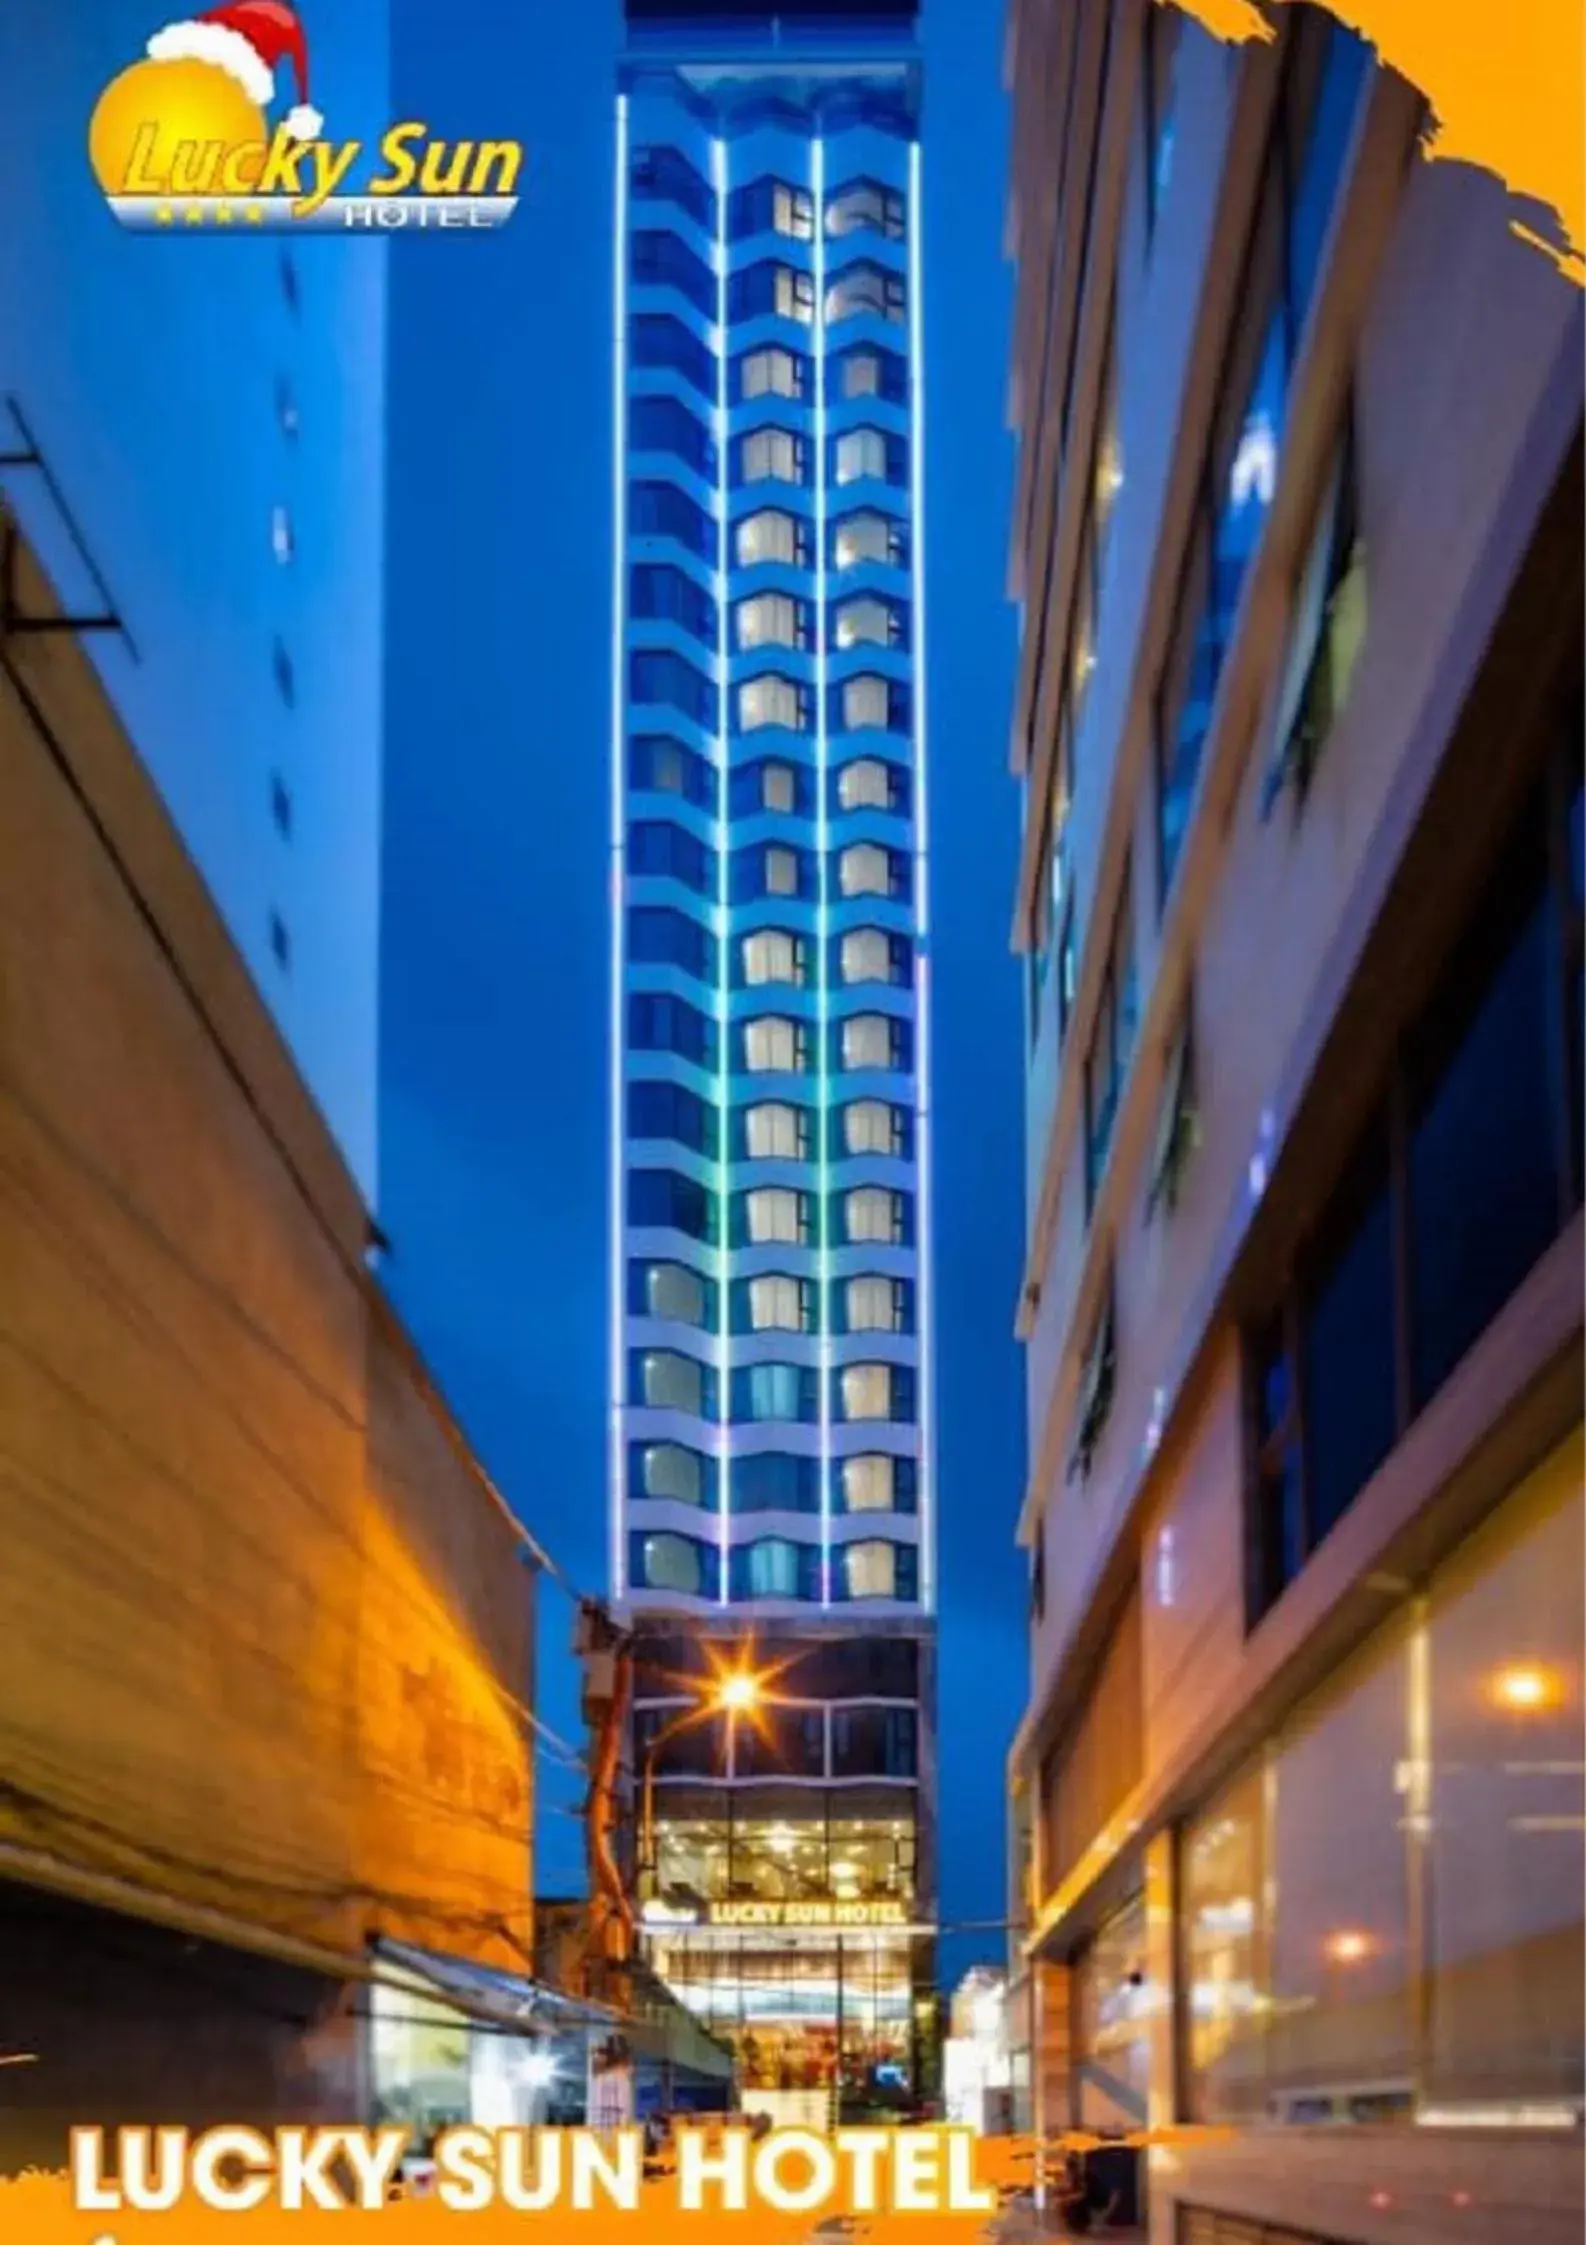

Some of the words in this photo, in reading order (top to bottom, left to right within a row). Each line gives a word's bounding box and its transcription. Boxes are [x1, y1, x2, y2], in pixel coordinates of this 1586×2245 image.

[711, 1902, 783, 1925] LUCKY
[784, 1902, 831, 1925] SUN
[834, 1902, 907, 1925] HOTEL
